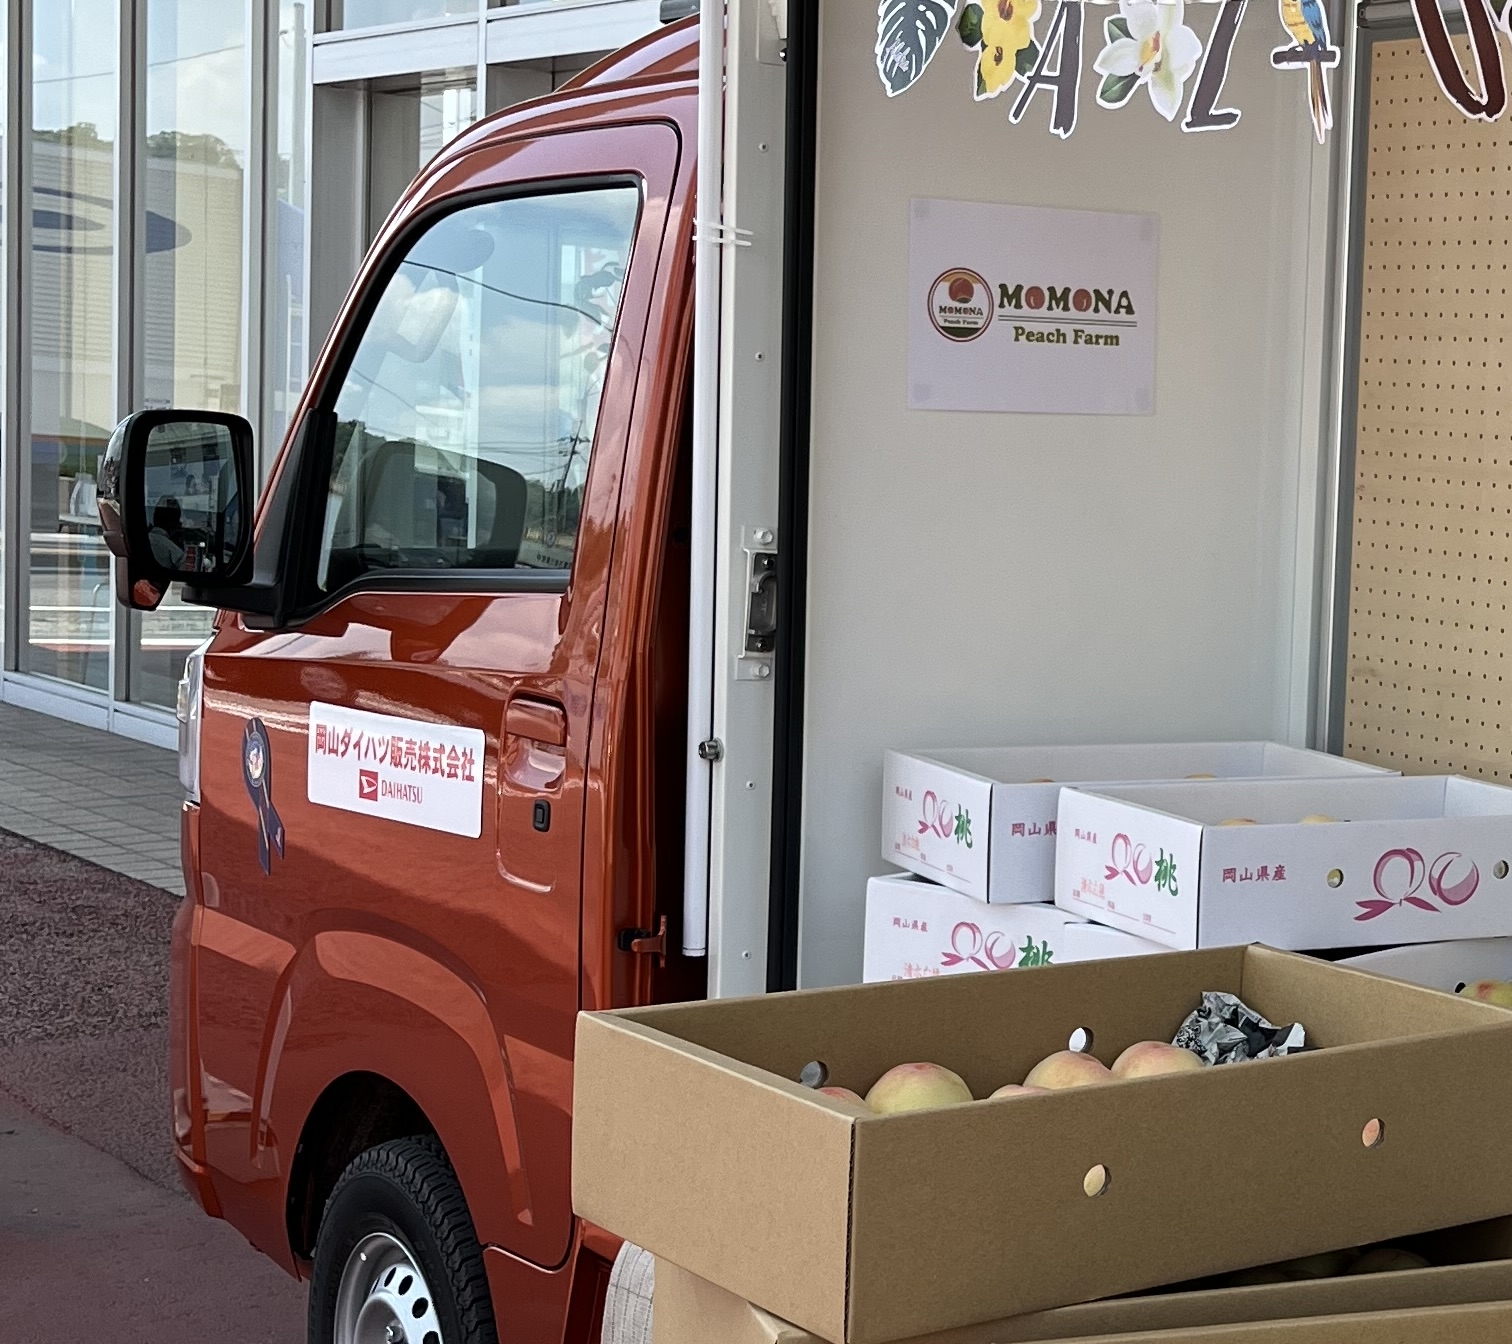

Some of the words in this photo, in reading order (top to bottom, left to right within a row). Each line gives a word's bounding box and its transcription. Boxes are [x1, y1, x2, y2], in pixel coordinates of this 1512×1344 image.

[998, 283, 1135, 315] MOMONA
[1013, 326, 1067, 344] Peach
[1073, 329, 1120, 346] Farm
[315, 724, 475, 782] 岡山ダイハツ販売株式会社
[381, 779, 423, 804] DAIHATSU
[1155, 847, 1179, 897] 桃
[1222, 864, 1287, 883] 岡山県産
